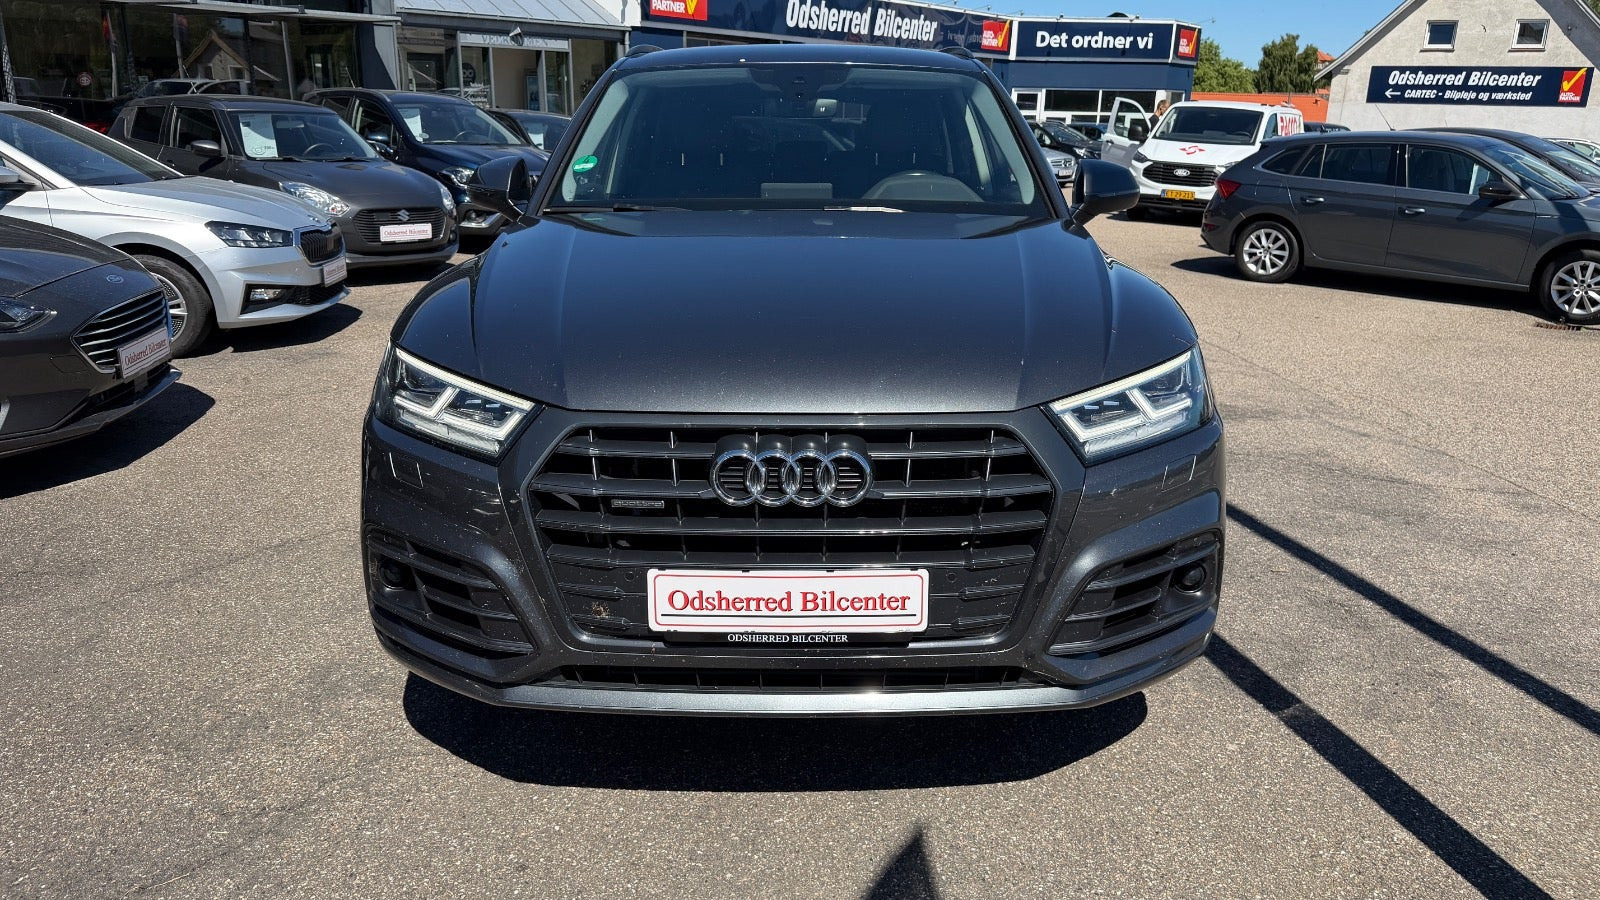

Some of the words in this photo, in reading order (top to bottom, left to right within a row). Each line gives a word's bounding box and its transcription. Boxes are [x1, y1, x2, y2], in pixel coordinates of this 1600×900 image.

[652, 0, 686, 13] PARTNER
[786, 0, 872, 35] Odsherred
[874, 8, 938, 41] Bilcenter
[1036, 30, 1068, 48] Det
[1071, 31, 1133, 49] ordner
[1137, 32, 1154, 50] vi
[1388, 70, 1467, 86] Odsherred
[1467, 71, 1542, 87] Bilcenter
[1404, 89, 1437, 99] CARTEC
[1443, 90, 1477, 101] Bilpleje
[1478, 92, 1490, 101] og
[1491, 91, 1533, 101] værksted
[667, 589, 794, 612] Odsherred
[799, 591, 910, 612] Bilcenter
[727, 633, 790, 643] ODSHERRED
[791, 634, 849, 643] BILCENTER
